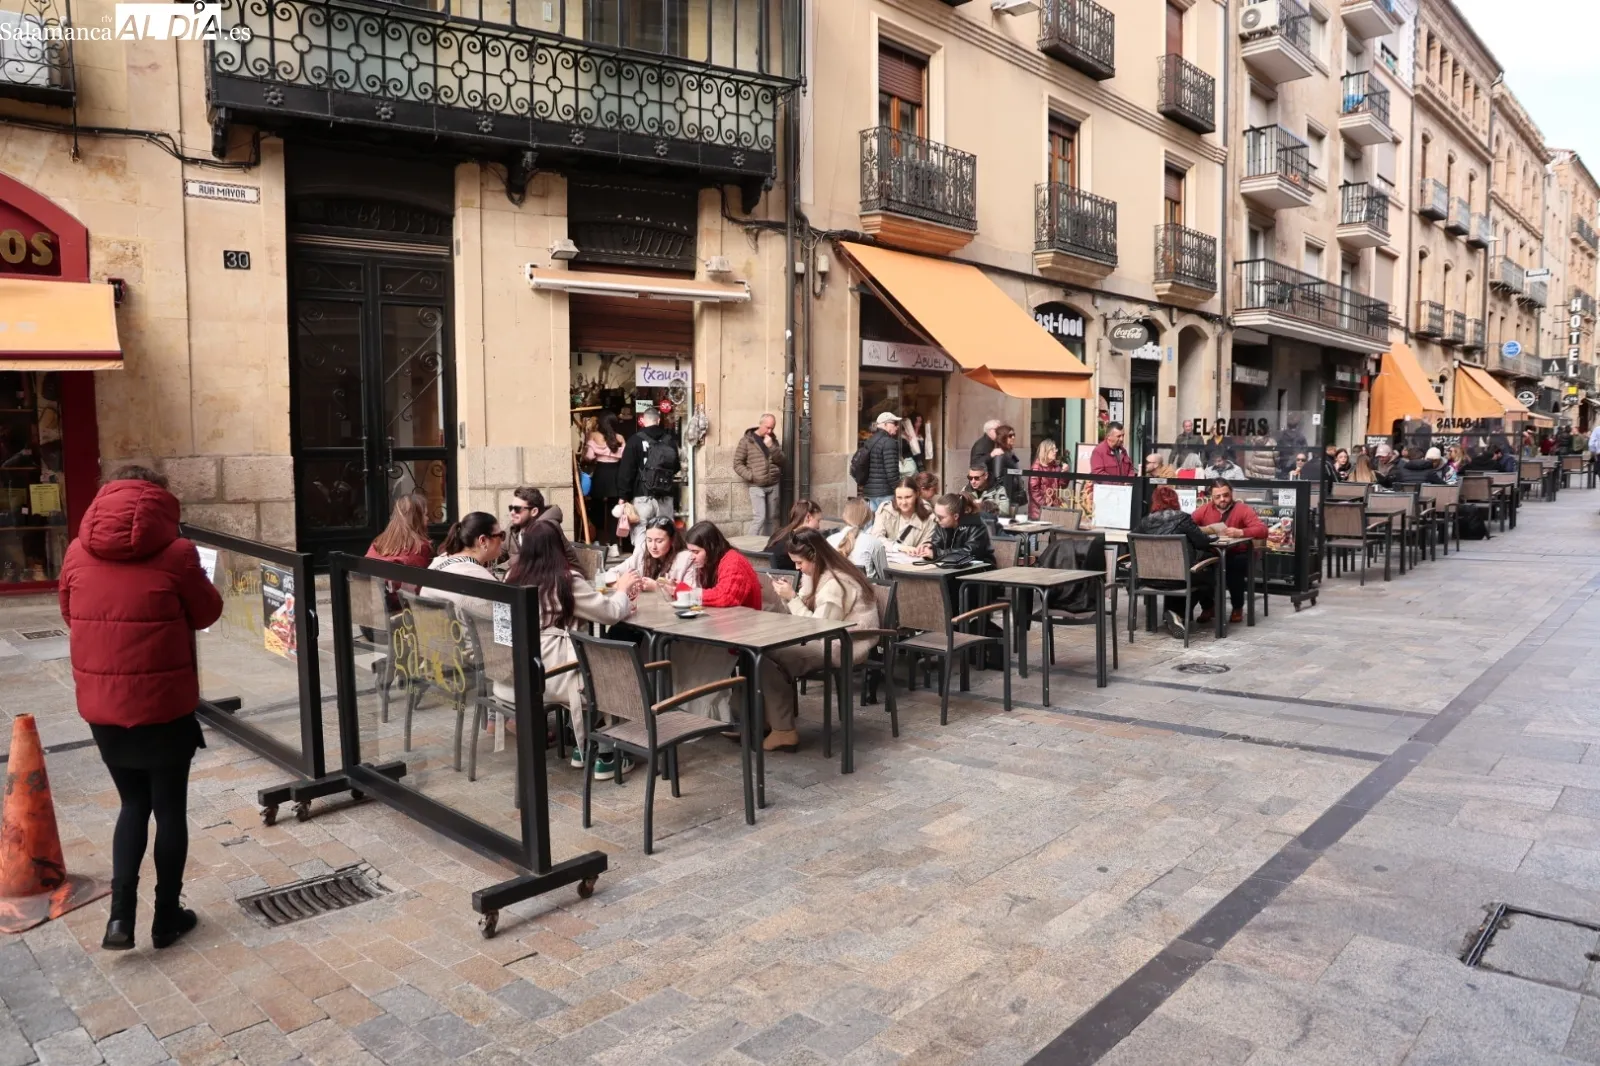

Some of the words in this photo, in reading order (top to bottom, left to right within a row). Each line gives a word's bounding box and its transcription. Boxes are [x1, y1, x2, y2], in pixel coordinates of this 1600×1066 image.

[198, 184, 215, 195] RUA
[216, 187, 246, 199] MAYOR
[226, 251, 249, 268] 30
[1032, 312, 1084, 338] ast-food
[1567, 298, 1583, 378] HOTEL
[911, 353, 949, 370] ABUELA
[1193, 418, 1211, 436] EL
[1215, 418, 1269, 437] GAFAS
